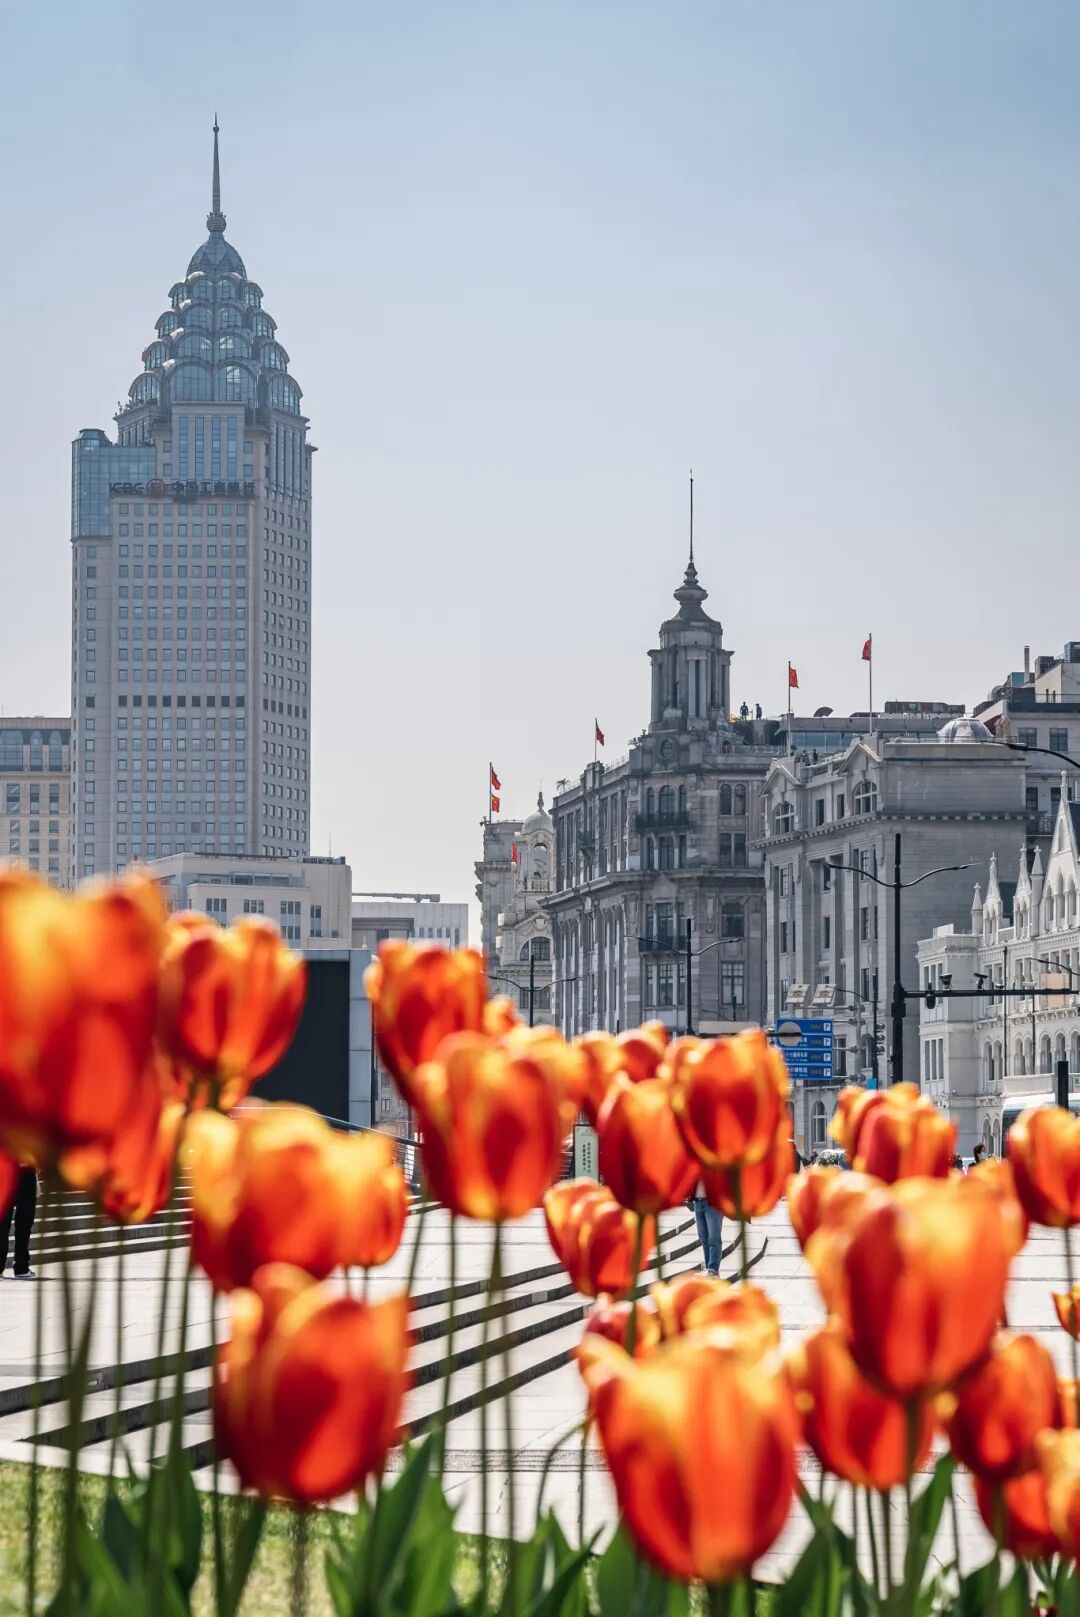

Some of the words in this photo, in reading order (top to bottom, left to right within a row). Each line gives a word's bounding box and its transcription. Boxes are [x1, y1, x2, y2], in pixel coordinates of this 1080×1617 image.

[109, 482, 144, 493] ICBC
[172, 481, 255, 496] 中国工商银行
